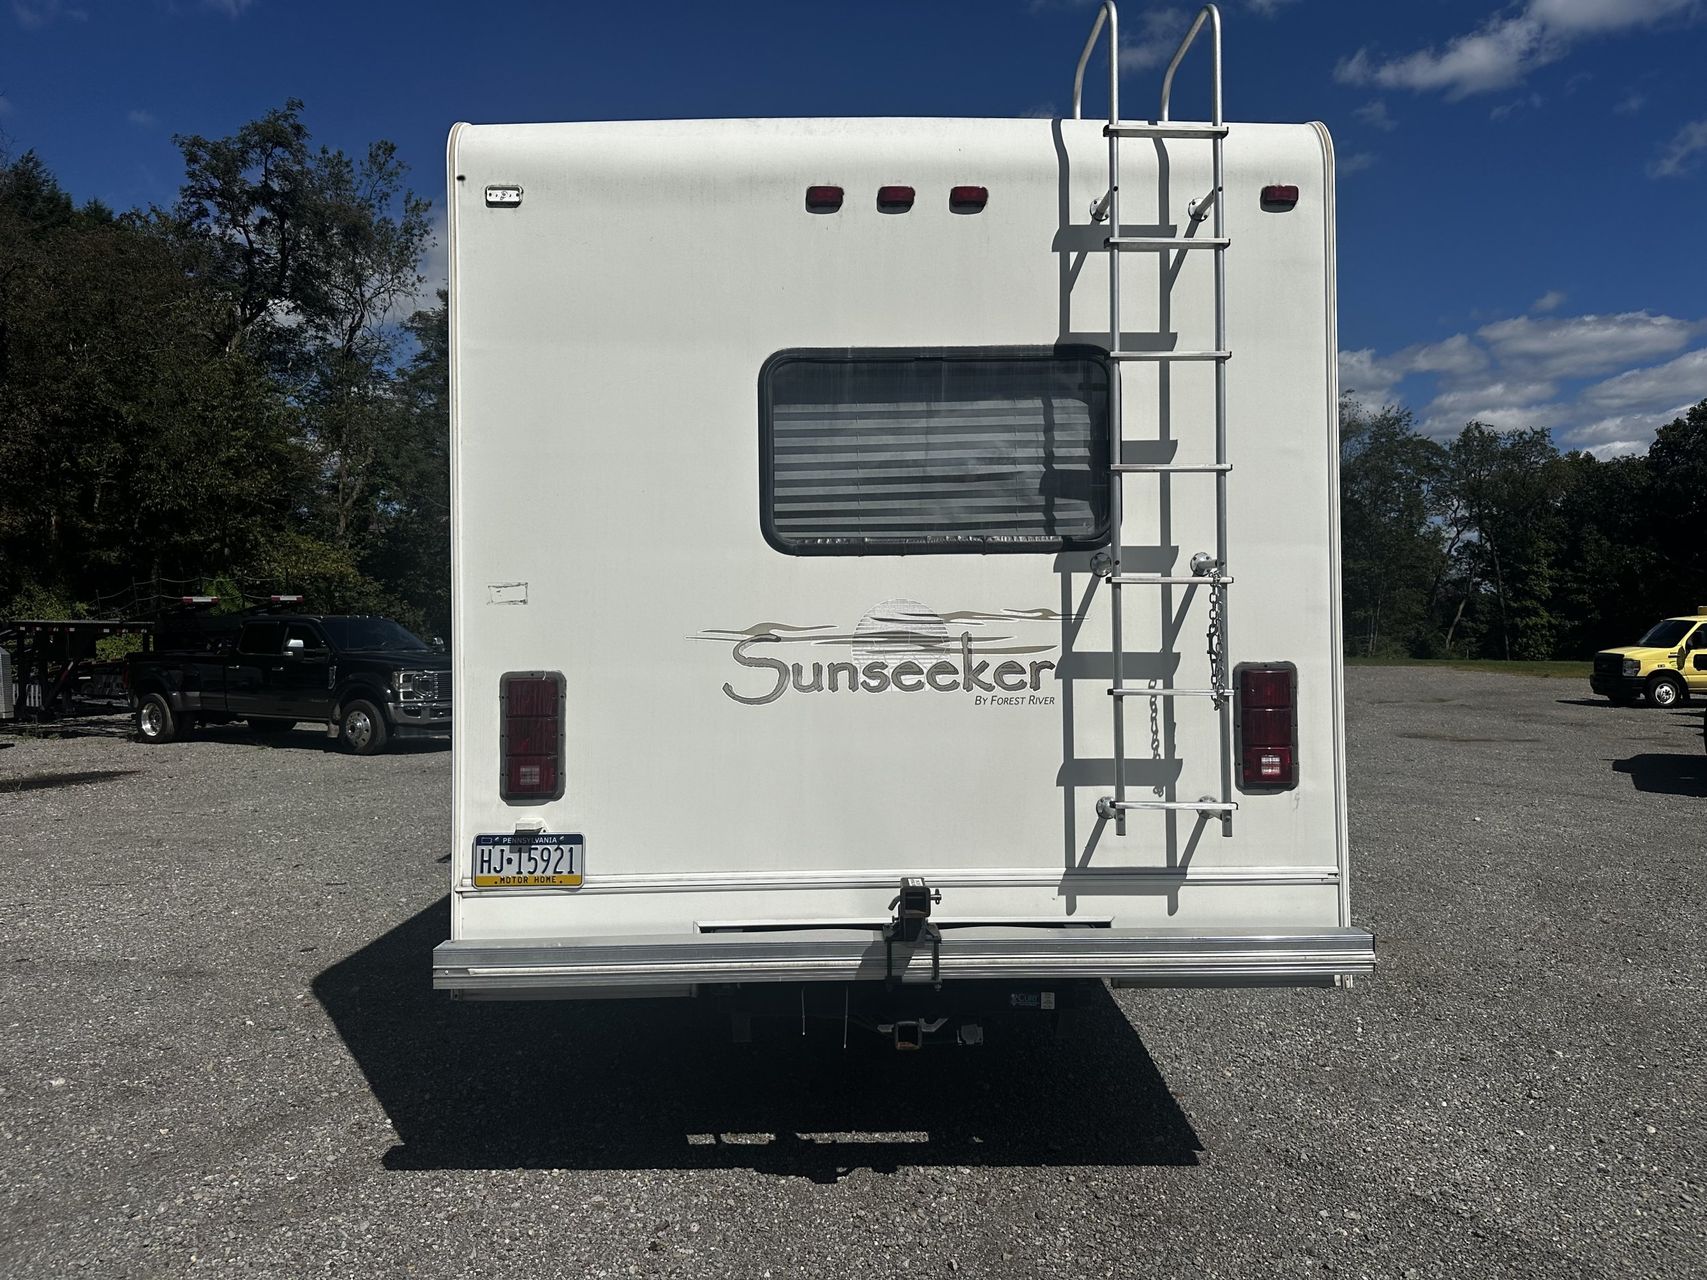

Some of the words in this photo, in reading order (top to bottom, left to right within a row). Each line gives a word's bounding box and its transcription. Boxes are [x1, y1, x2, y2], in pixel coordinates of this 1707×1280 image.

[722, 631, 1055, 705] Sunseeker
[500, 876, 529, 884] MOTOR
[534, 876, 557, 884] HOME
